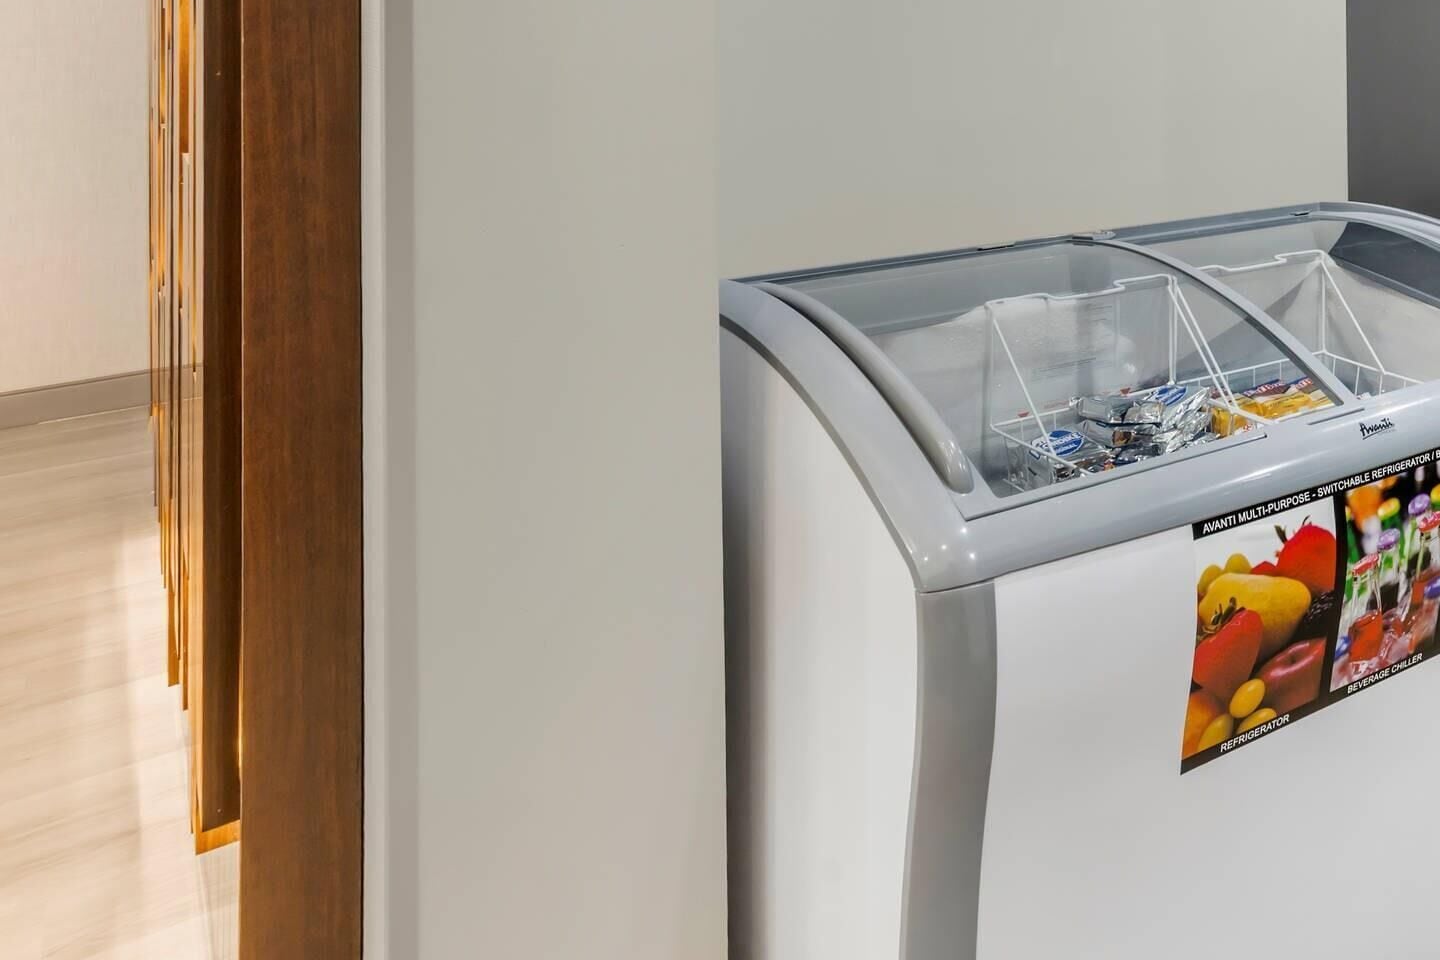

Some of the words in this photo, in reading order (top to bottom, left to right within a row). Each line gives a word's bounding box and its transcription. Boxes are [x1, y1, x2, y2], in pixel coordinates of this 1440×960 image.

[1202, 516, 1236, 534] AVANTI
[1238, 492, 1311, 523] MULTI-PURPOSE
[1318, 472, 1371, 498] SWITCHABLE
[1371, 453, 1431, 480] REFRIGERATOR
[1347, 669, 1390, 694] BEVERAGE
[1391, 652, 1423, 673] CHILLER
[1220, 713, 1290, 753] REFRIGERATOR
